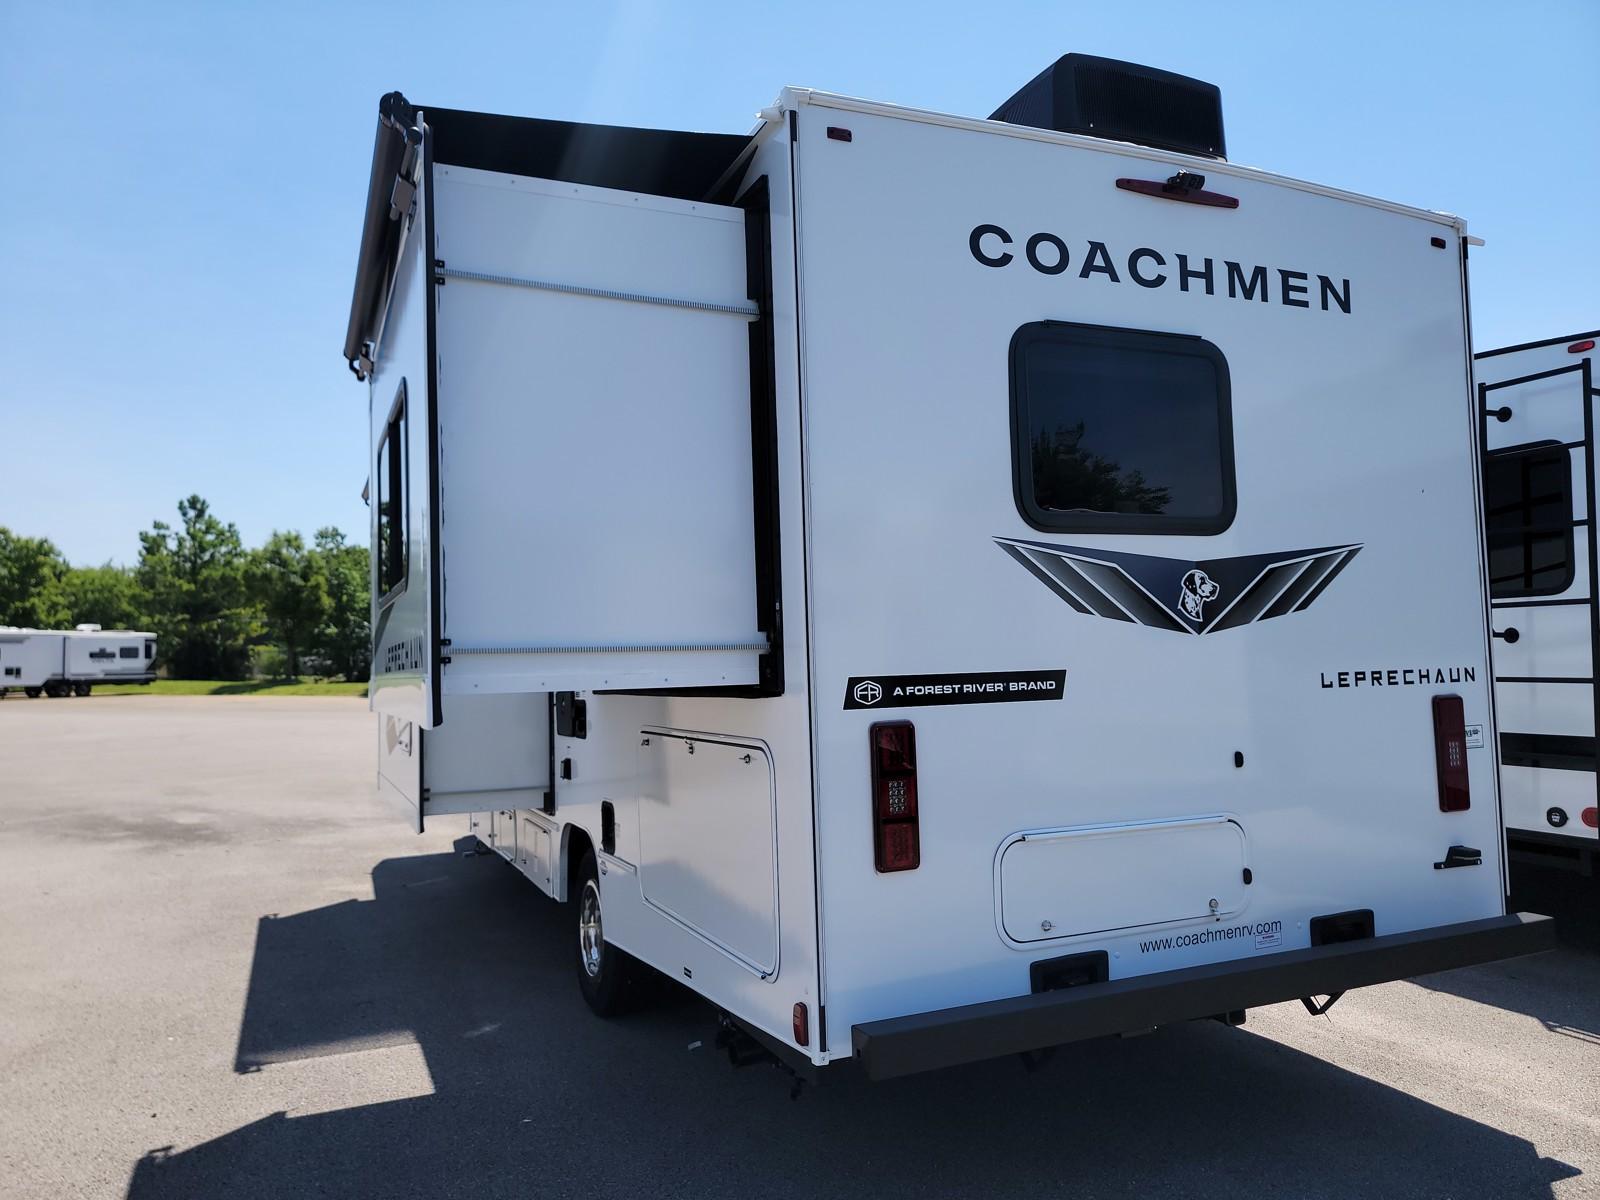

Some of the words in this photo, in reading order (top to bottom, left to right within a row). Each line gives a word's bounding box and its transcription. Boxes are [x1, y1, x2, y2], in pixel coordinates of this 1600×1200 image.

[968, 223, 1352, 314] COACHMEN
[893, 686, 904, 697] A
[906, 684, 961, 696] FOREST
[1009, 680, 1056, 692] BRAND
[1320, 666, 1476, 689] LEPRECHAUN
[1139, 920, 1282, 954] www.coachmenrv.com
